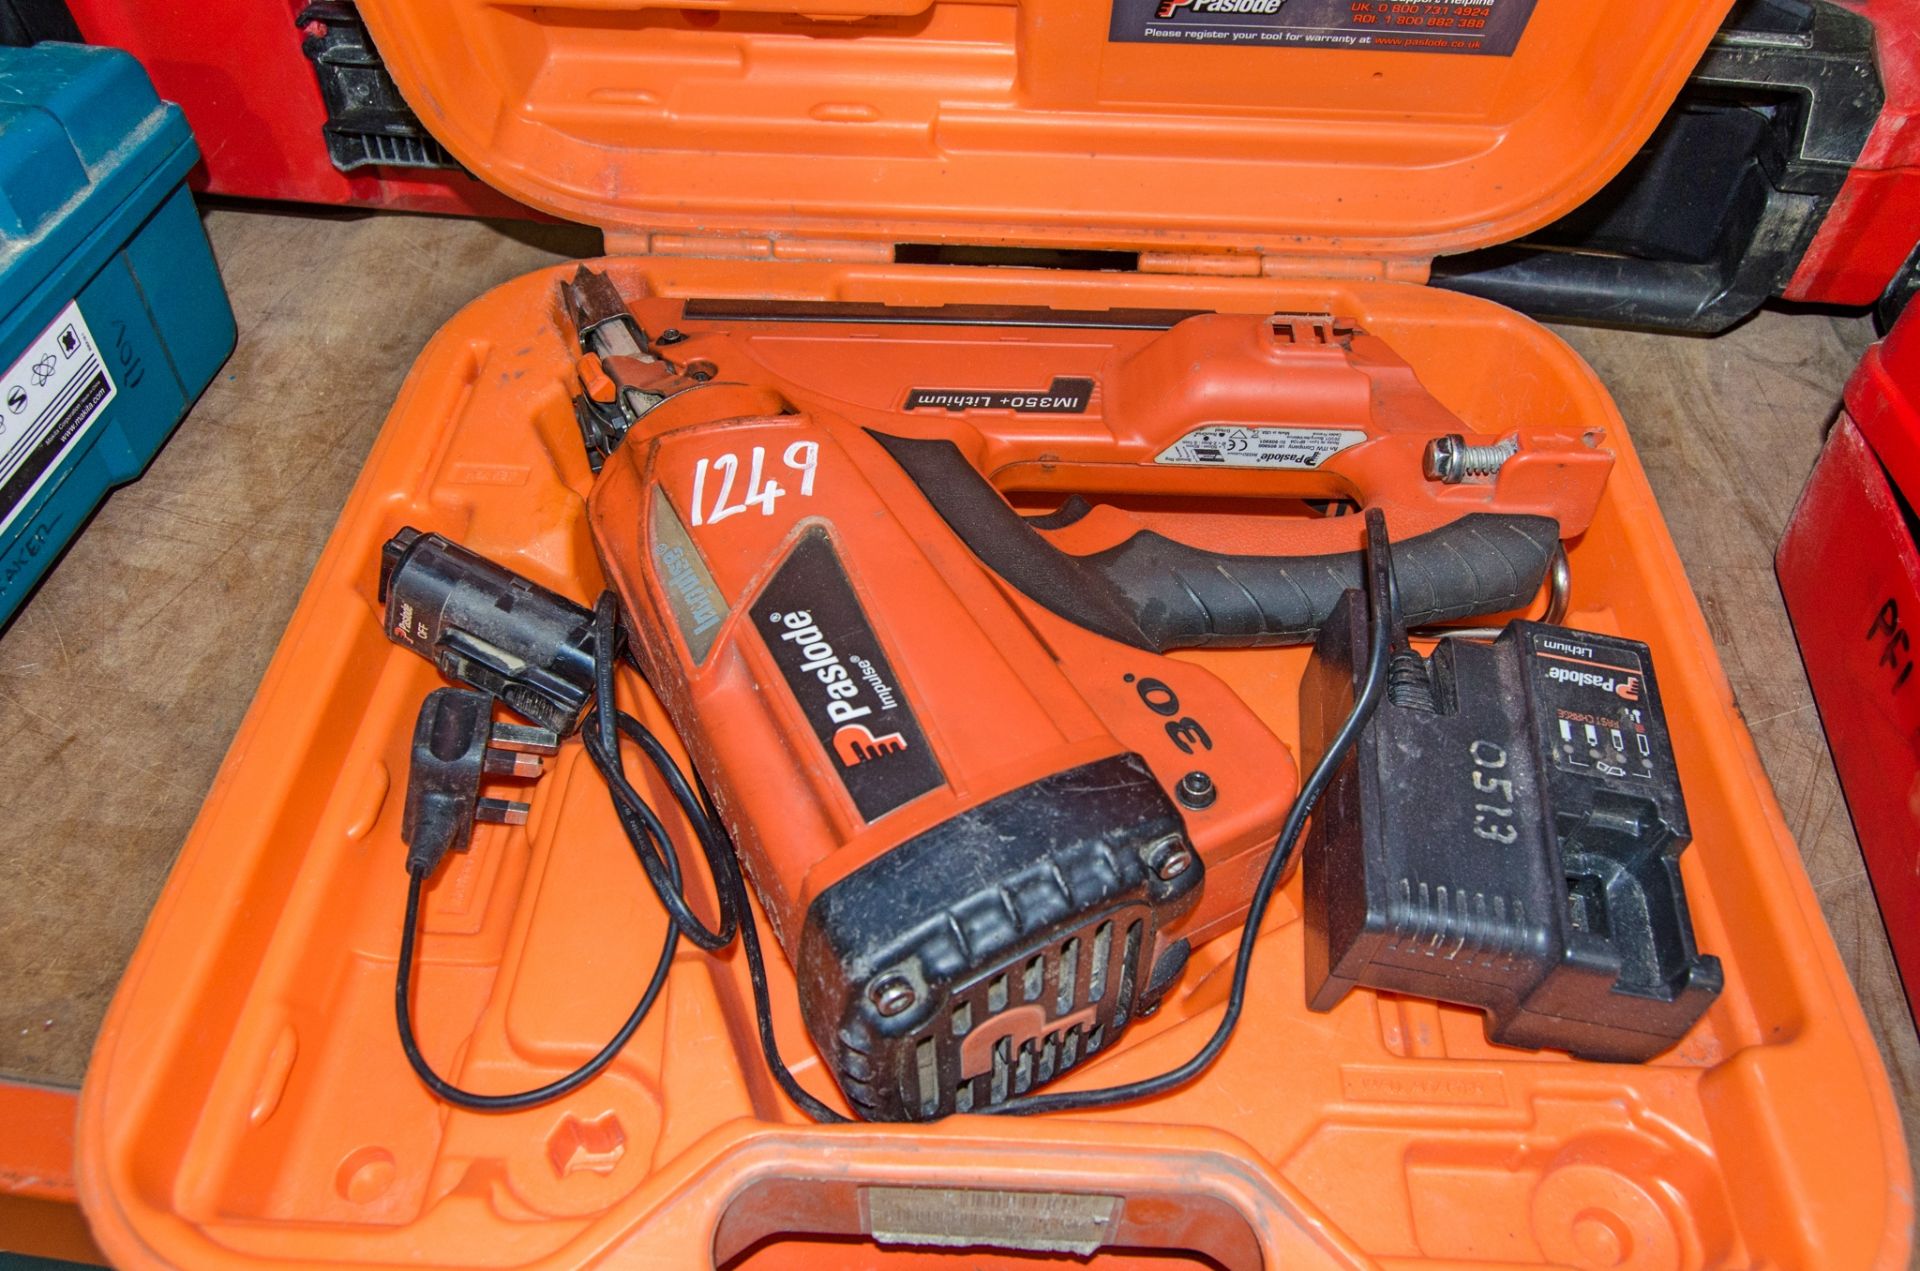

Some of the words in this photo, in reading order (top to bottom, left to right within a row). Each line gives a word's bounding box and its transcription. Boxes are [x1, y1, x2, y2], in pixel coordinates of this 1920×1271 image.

[1378, 4, 1387, 12] 0
[1392, 4, 1419, 14] 800
[1424, 5, 1448, 15] 731
[1453, 7, 1490, 17] 4924
[1144, 28, 1181, 38] Please
[1185, 30, 1229, 40] register
[1232, 32, 1257, 41] your
[1260, 32, 1282, 41] tool
[1285, 32, 1302, 41] for
[1305, 34, 1357, 45] warranty
[1359, 36, 1372, 44] at
[1375, 37, 1481, 49] www.paslode.co.uk
[918, 395, 991, 407] Lithium
[1000, 396, 1079, 409] IM350+
[60, 388, 106, 443] www.makita.com
[691, 440, 819, 527] 1249
[398, 602, 414, 633] Paslode
[417, 621, 429, 640] OFF
[1544, 640, 1593, 658] Lithium
[1549, 667, 1614, 692] Paslode
